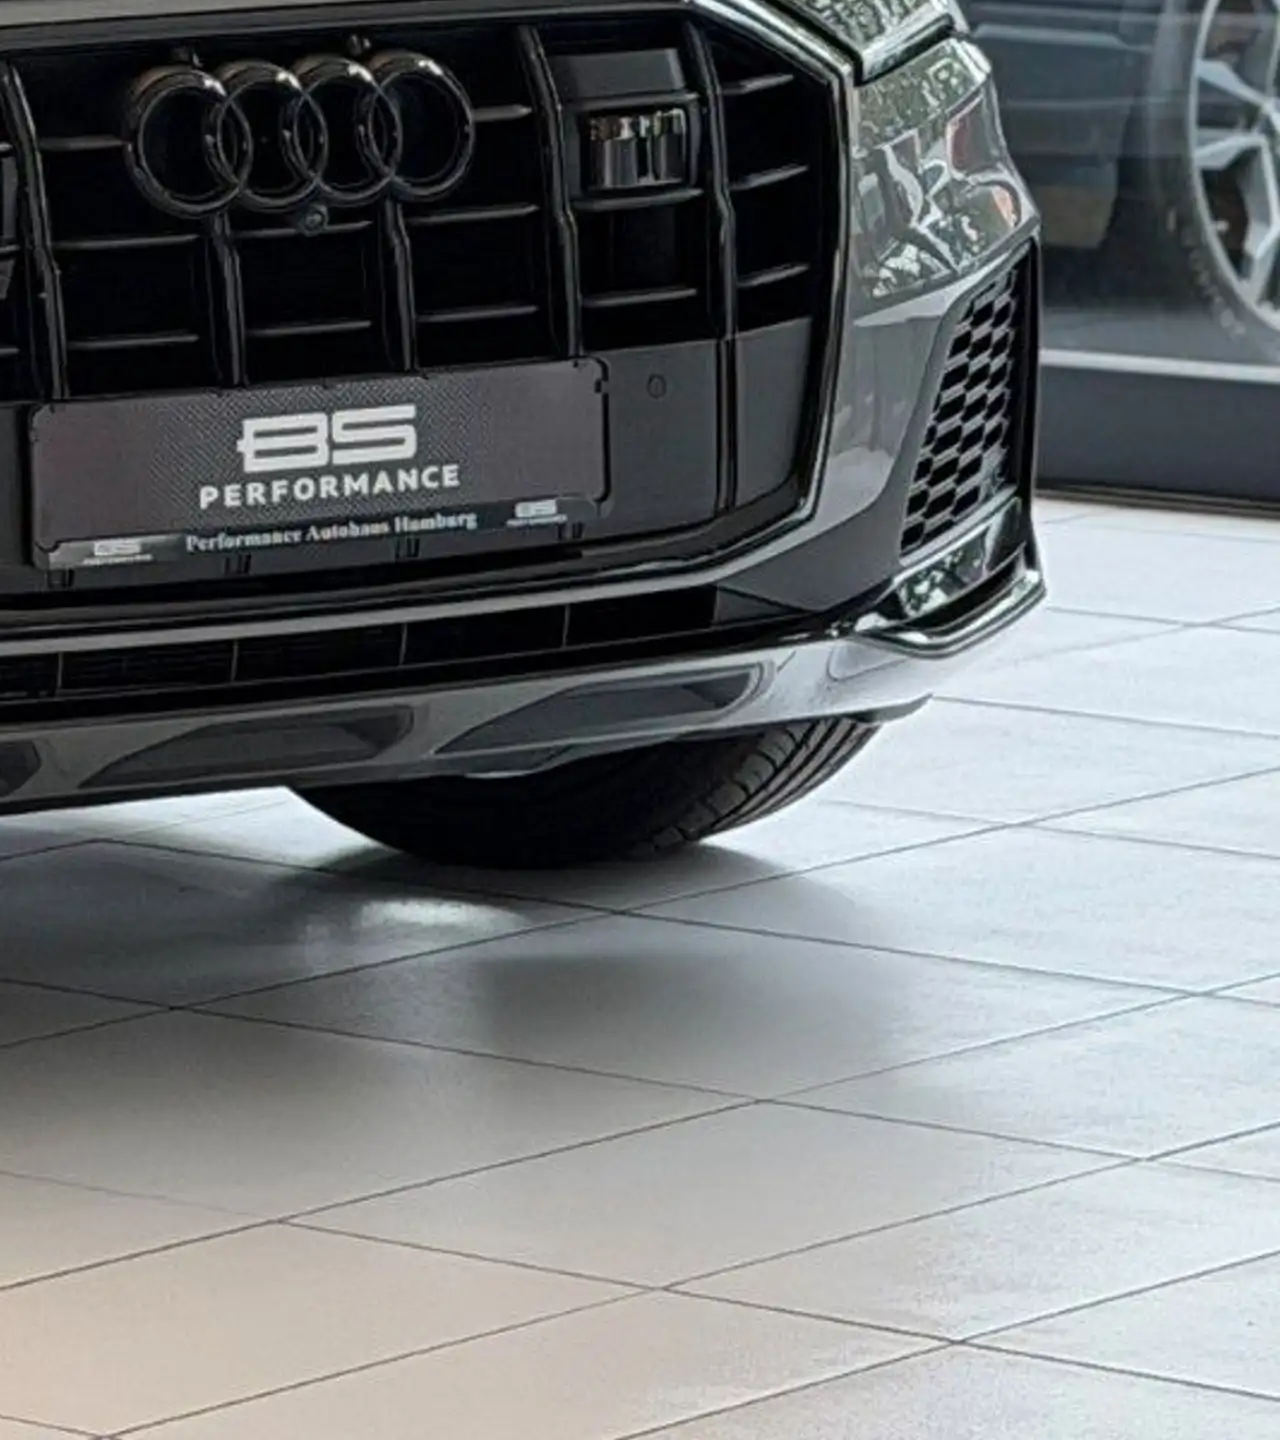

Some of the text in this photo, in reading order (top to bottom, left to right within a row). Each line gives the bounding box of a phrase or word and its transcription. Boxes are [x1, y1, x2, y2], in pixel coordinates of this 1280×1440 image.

[199, 464, 460, 509] PERFORMANCE
[186, 513, 478, 551] Performance Autohaus Hamburg
